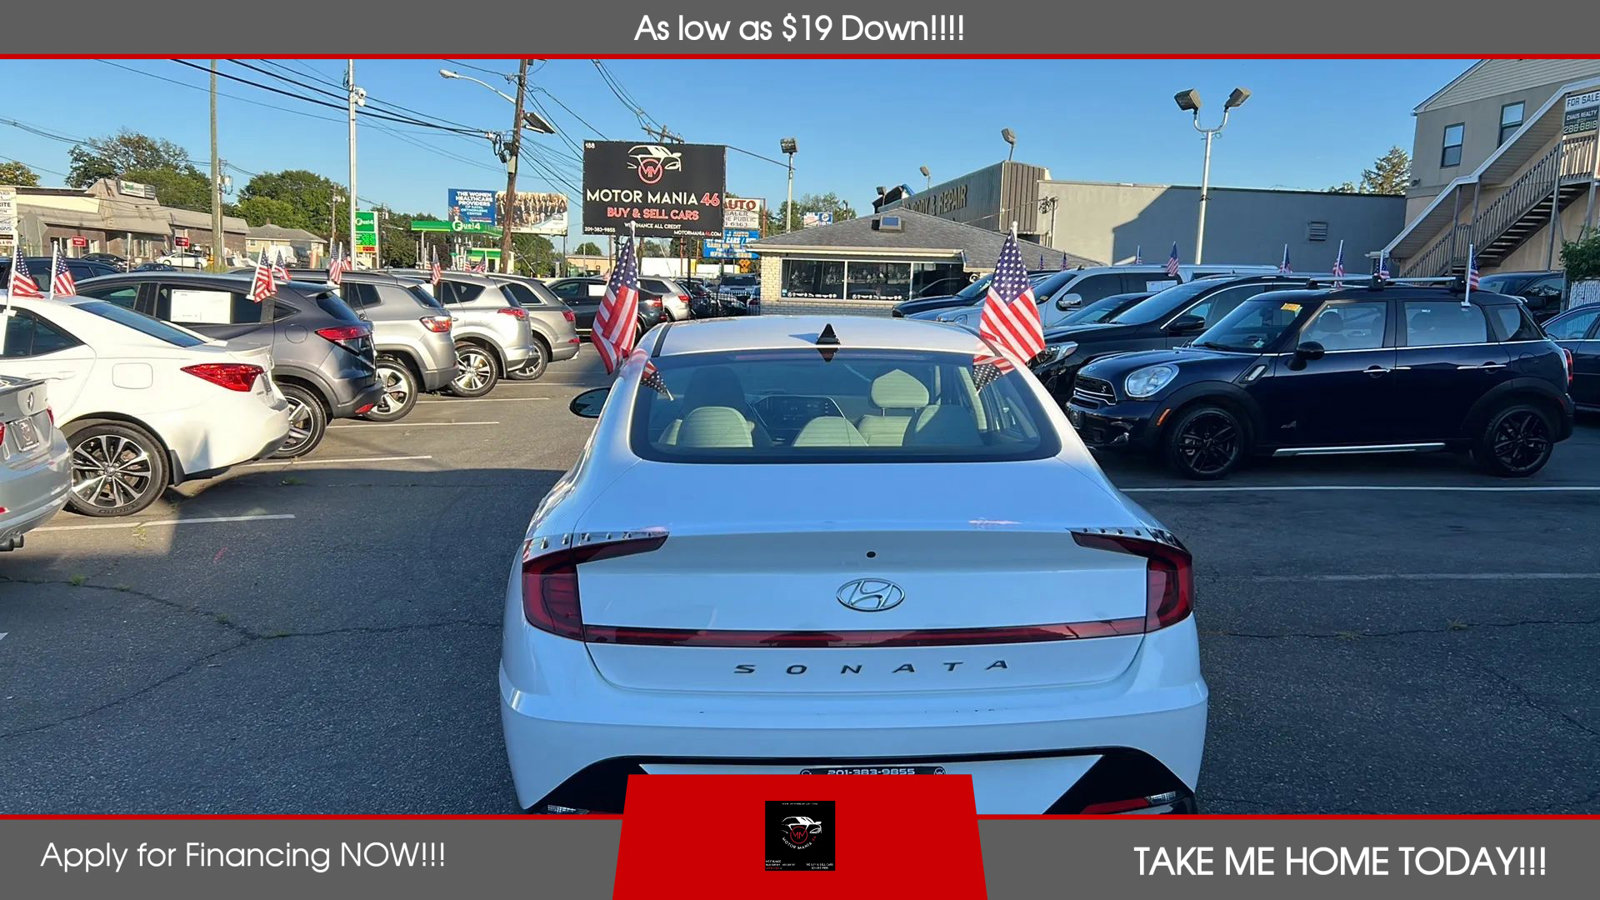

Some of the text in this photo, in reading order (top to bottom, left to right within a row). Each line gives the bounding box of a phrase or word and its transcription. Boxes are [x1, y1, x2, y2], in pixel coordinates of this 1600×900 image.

[1567, 93, 1600, 107] FOR SALE
[586, 188, 721, 207] MOTOR MANIA 46
[939, 184, 968, 214] REPAIR
[724, 199, 756, 211] AUTO
[607, 207, 699, 220] BUY & SELL CARS
[734, 660, 1008, 675] SONATA
